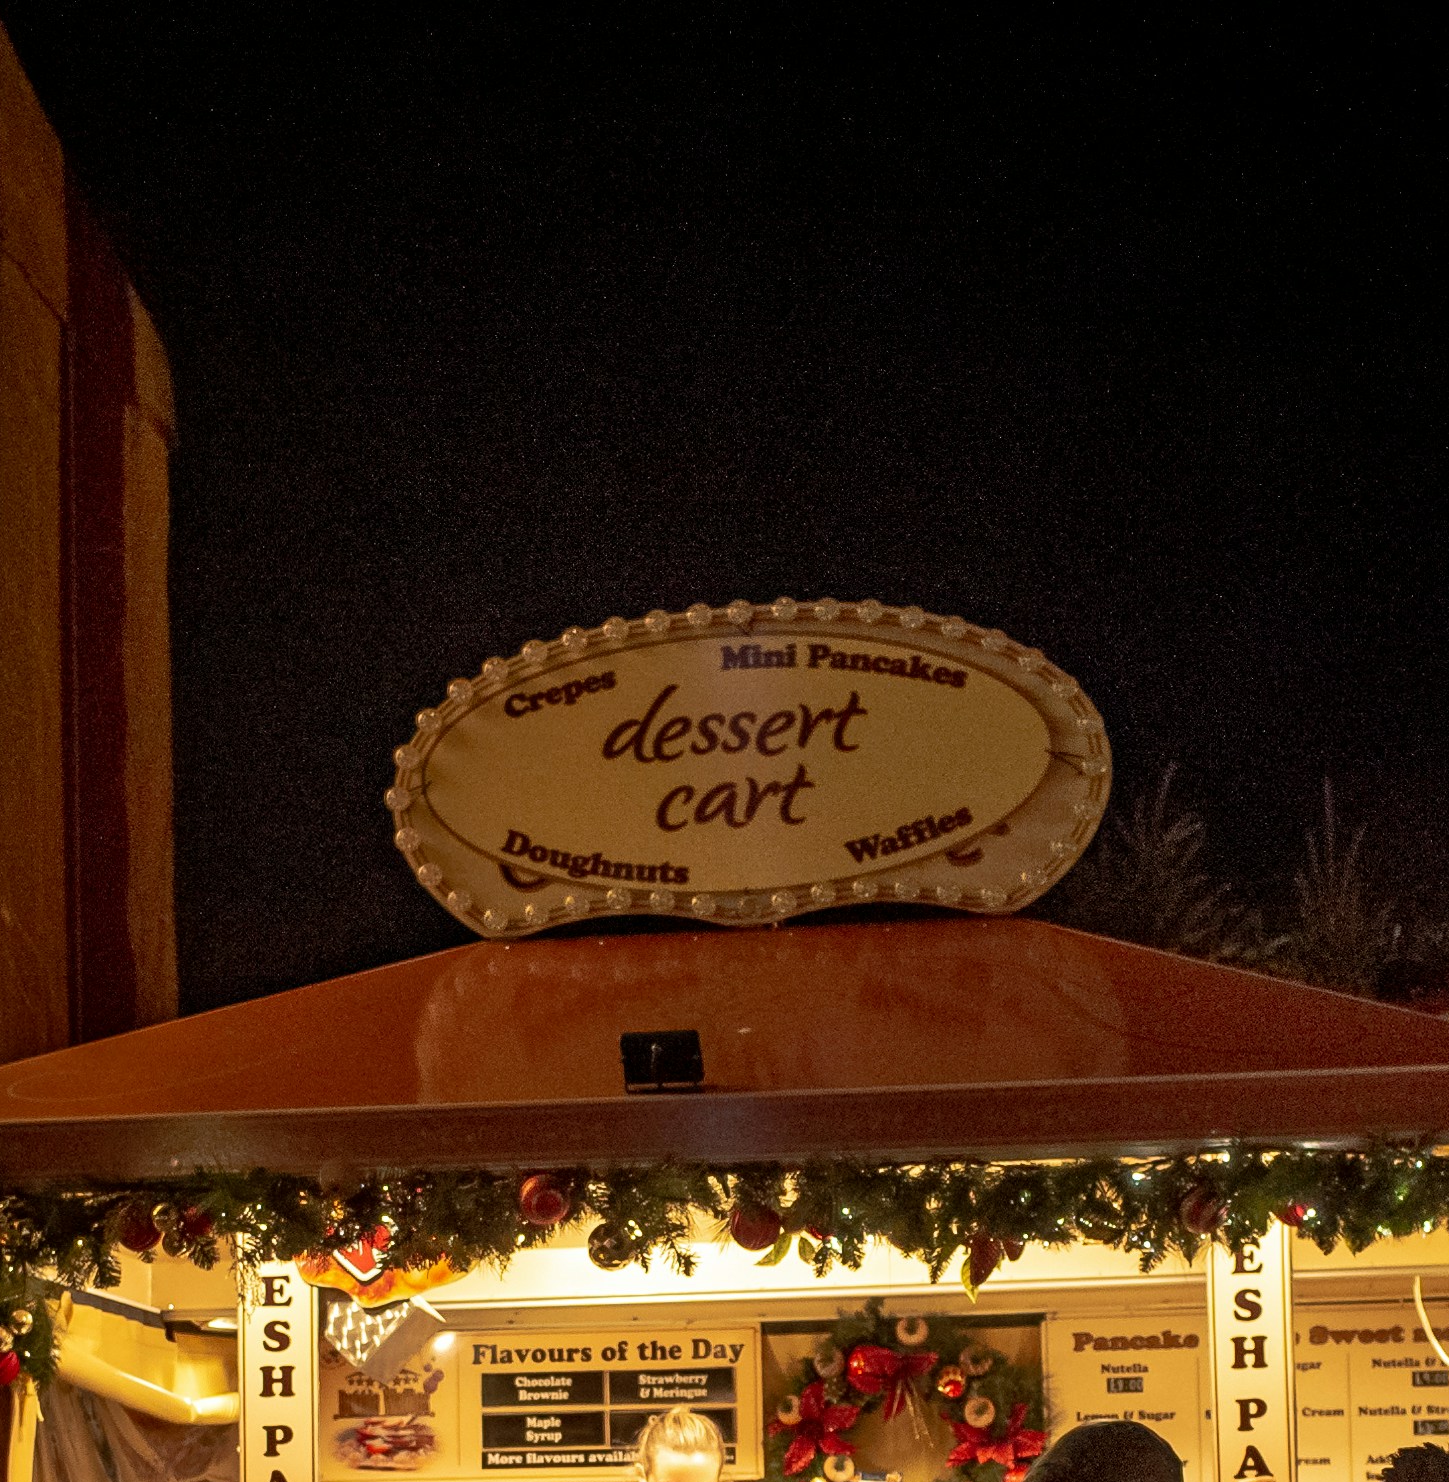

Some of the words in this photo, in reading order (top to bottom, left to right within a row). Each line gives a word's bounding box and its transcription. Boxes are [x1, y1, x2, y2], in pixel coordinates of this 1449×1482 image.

[722, 643, 796, 671] Mini
[806, 643, 968, 689] Pancakes
[504, 668, 617, 718] Crepes
[602, 685, 867, 764] dessert
[656, 764, 815, 832] cart
[844, 807, 973, 864] Waffles
[501, 829, 689, 884] Doughnuts
[1309, 1325, 1405, 1346] Sweet
[472, 1341, 592, 1365] Flavours
[601, 1340, 629, 1361] of
[637, 1340, 682, 1360] the
[691, 1338, 745, 1363] Day
[1100, 1363, 1149, 1375] Nutella
[1372, 1358, 1420, 1369] Nutella
[515, 1376, 572, 1388] Chocolate
[638, 1374, 708, 1386] Strawberry
[518, 1390, 569, 1401] Brownie
[653, 1387, 707, 1399] Meringue
[1138, 1410, 1176, 1422] Sugar
[1302, 1408, 1344, 1418] Cream
[1359, 1406, 1407, 1417] Nutella
[526, 1417, 562, 1429] Maple
[525, 1430, 562, 1443] Syrup
[487, 1453, 523, 1465] More
[526, 1452, 585, 1464] flavours
